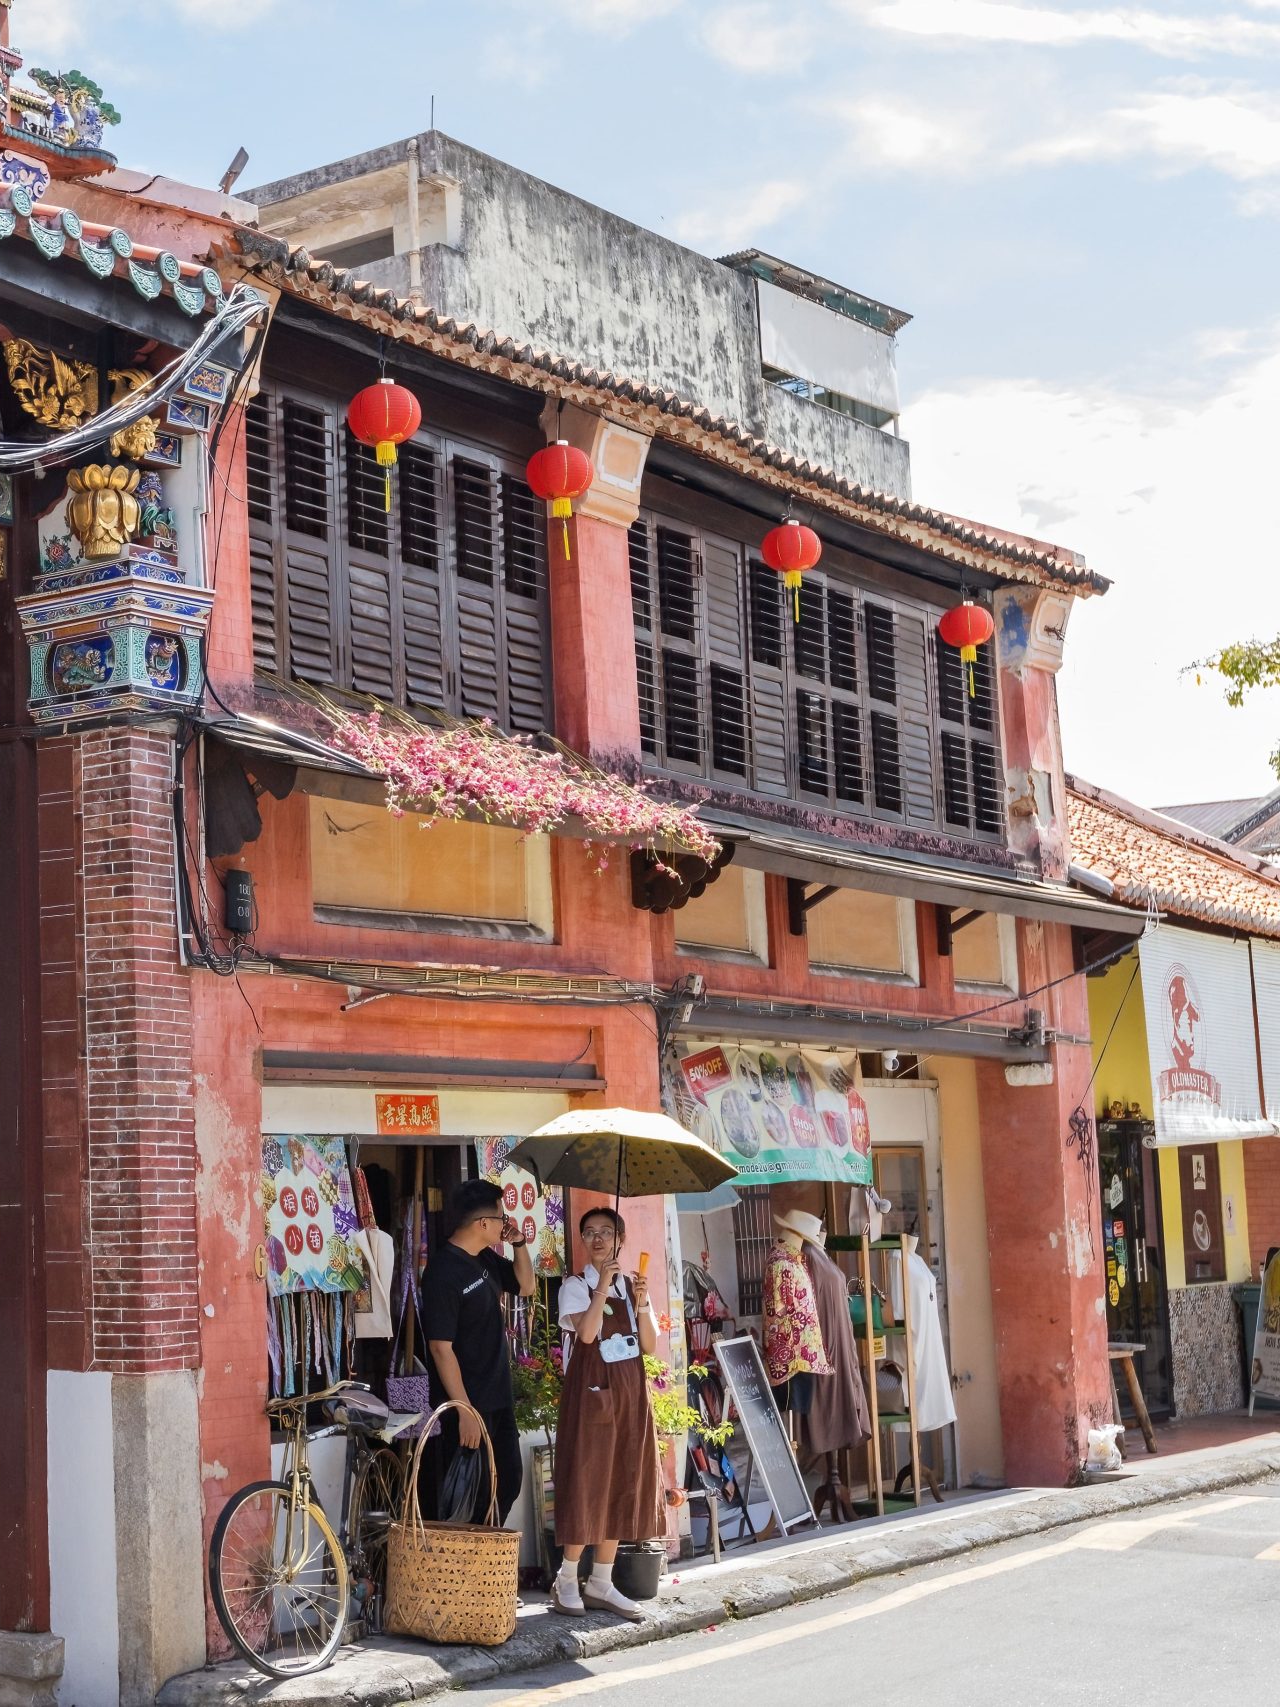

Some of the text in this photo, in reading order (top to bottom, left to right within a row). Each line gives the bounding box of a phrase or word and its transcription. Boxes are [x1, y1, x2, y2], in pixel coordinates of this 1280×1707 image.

[383, 1103, 434, 1126] 吉星高照
[792, 1116, 815, 1133] SHOP
